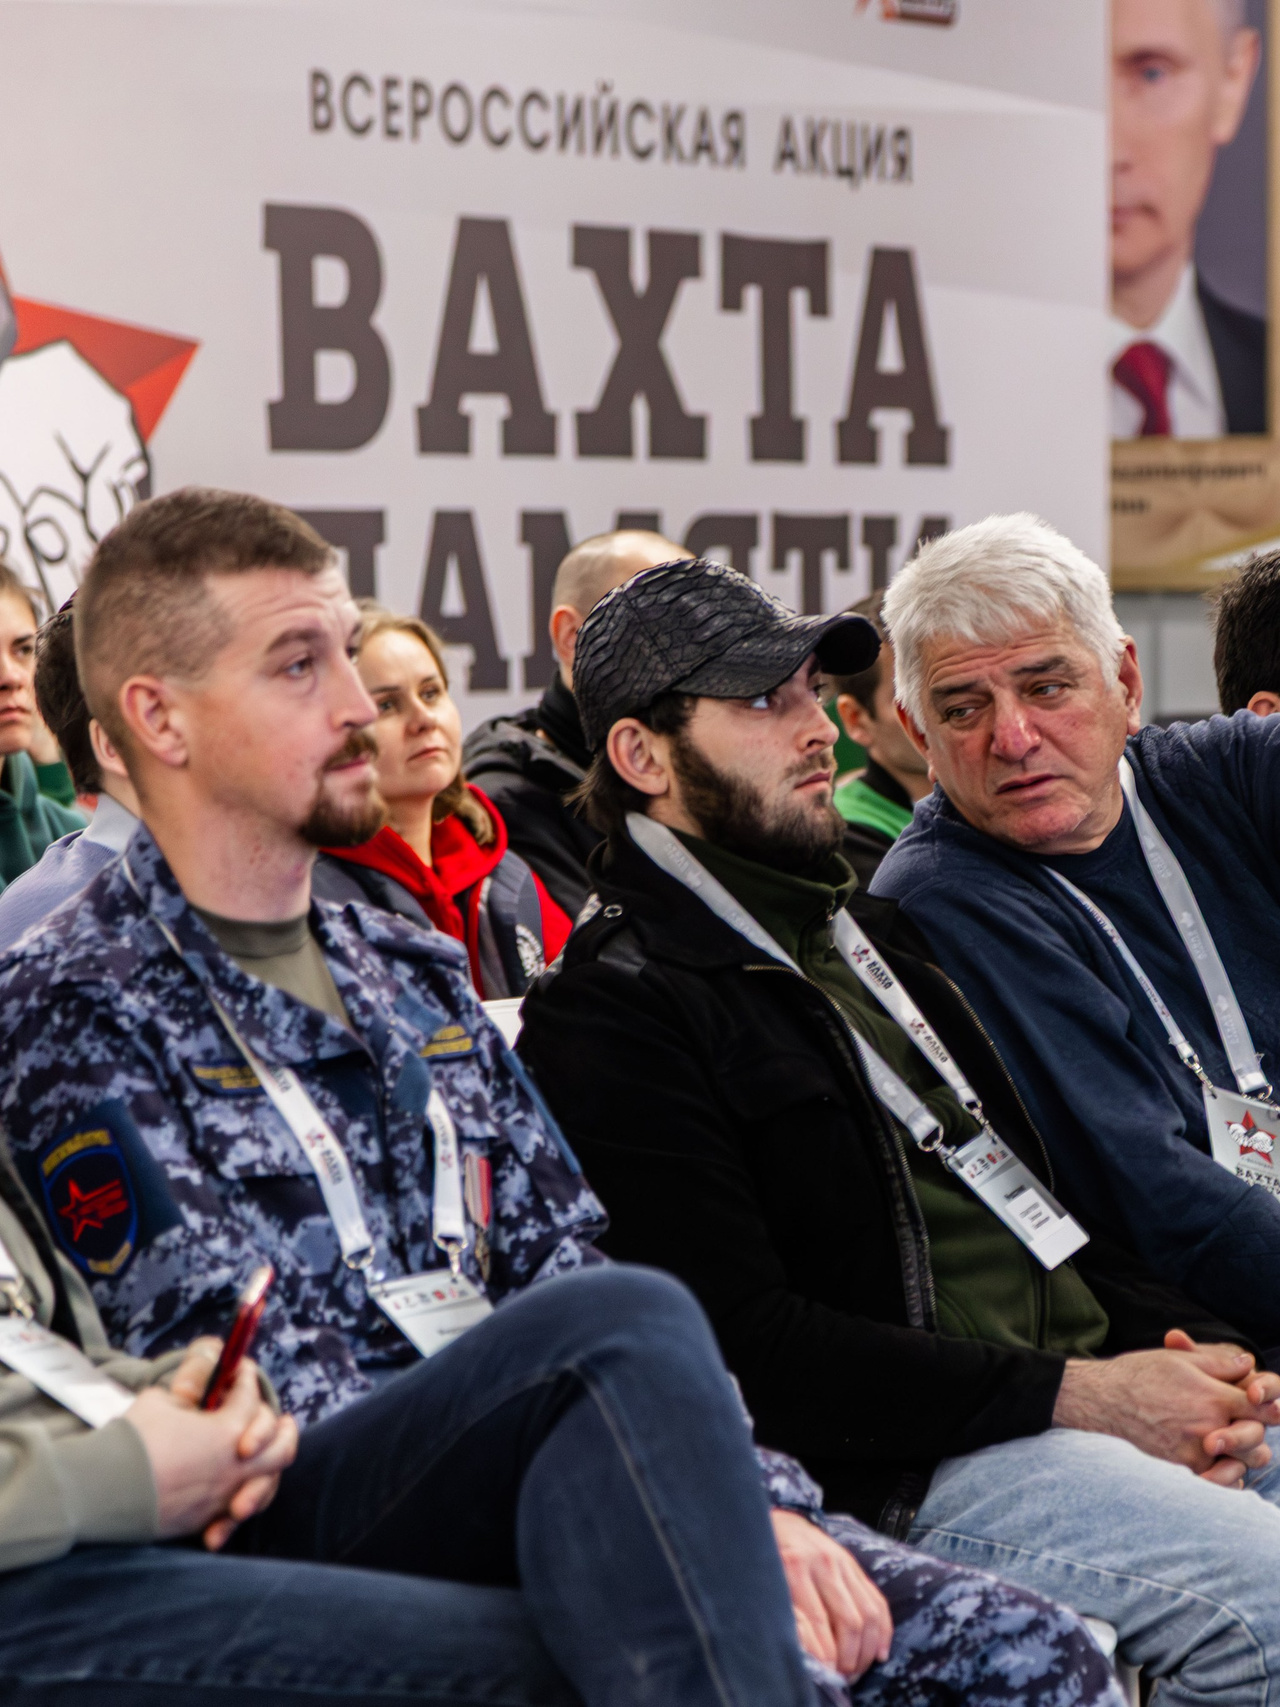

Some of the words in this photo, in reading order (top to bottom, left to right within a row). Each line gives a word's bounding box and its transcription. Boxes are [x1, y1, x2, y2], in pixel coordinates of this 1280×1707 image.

[309, 69, 747, 168] ВСЕРОССИЙСКАЯ
[773, 114, 912, 189] АКЦИЯ
[263, 203, 952, 468] ВАХТА
